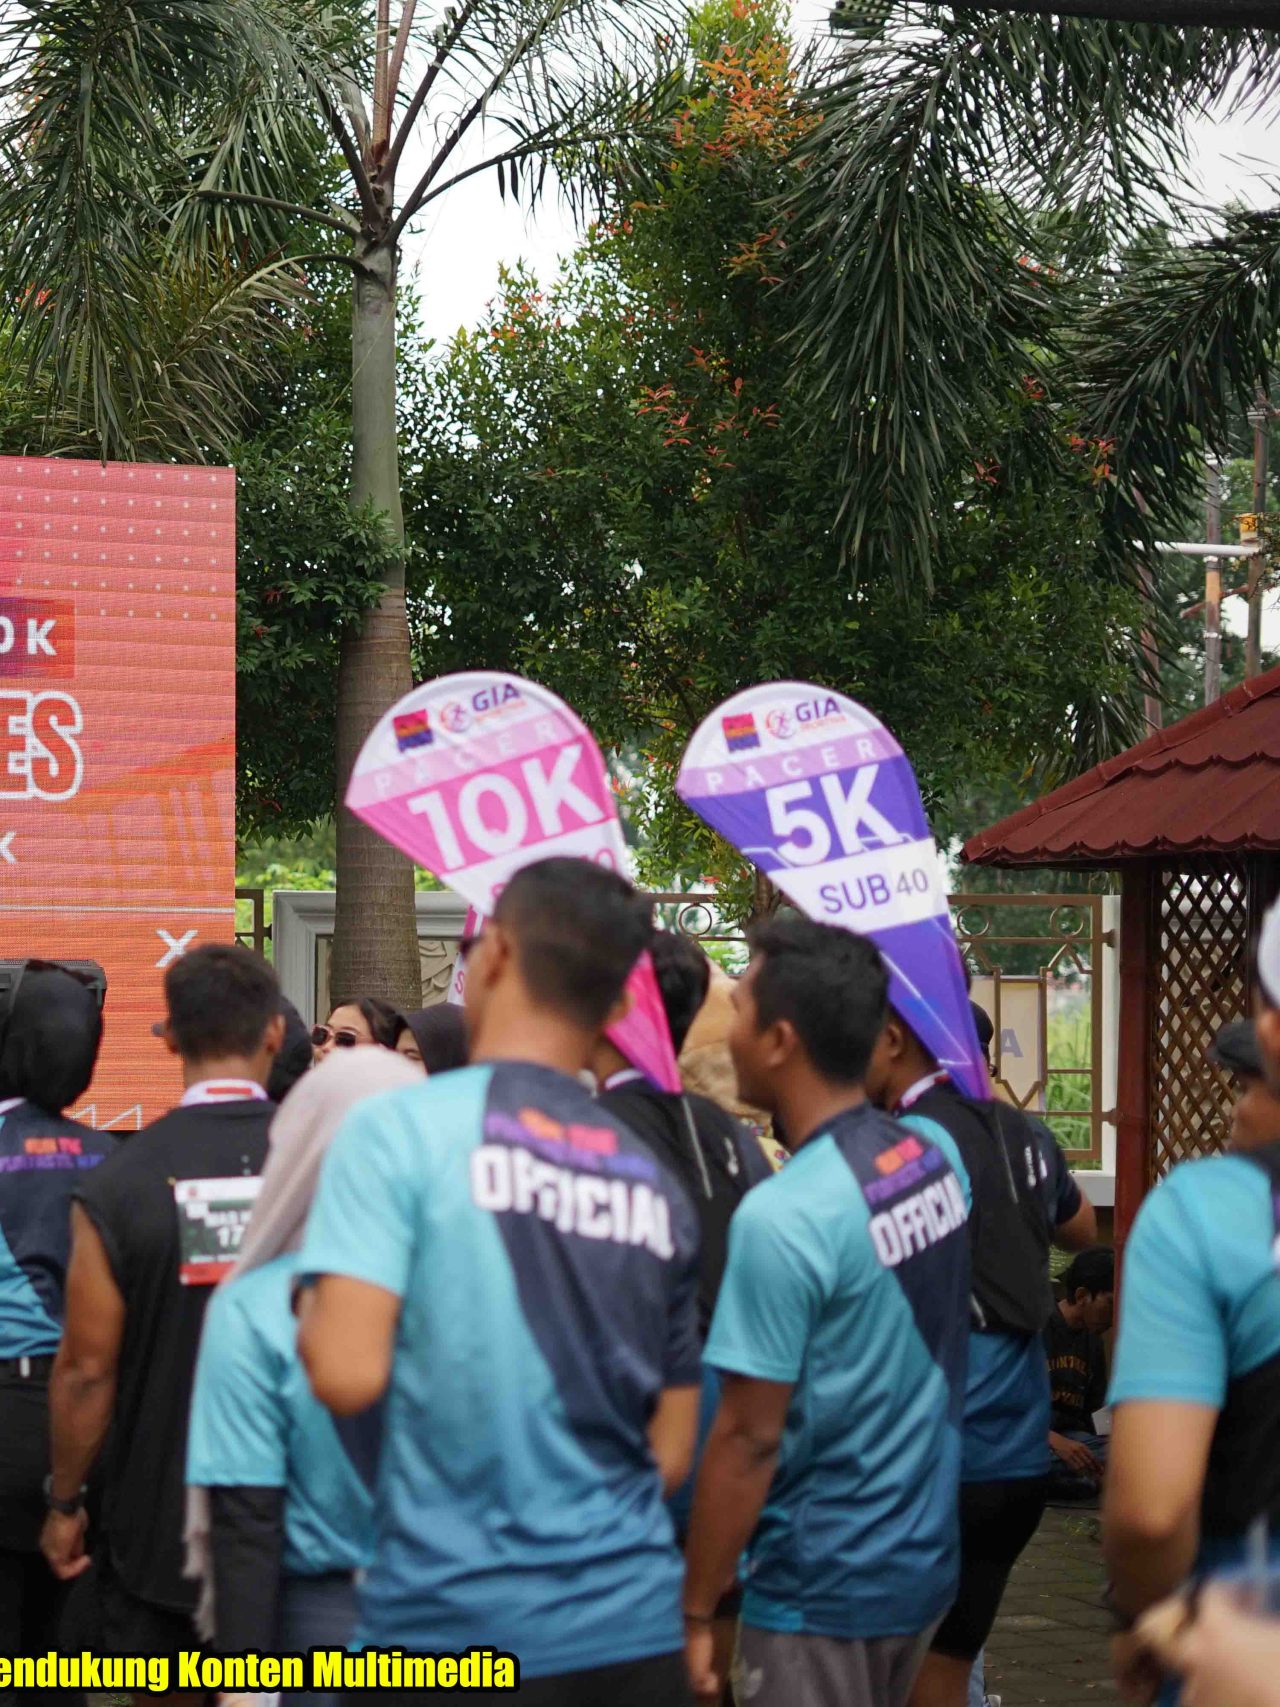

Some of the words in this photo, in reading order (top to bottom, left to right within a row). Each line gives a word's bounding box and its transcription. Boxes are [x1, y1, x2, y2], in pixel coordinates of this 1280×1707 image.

[26, 618, 58, 656] K
[471, 682, 520, 712] GIA
[795, 696, 841, 723] GIA
[374, 720, 557, 795] PACER
[705, 738, 876, 792] PACER
[406, 744, 606, 871] 10K
[765, 763, 904, 866] 5K
[820, 873, 891, 914] SUB
[896, 868, 929, 894] 40
[471, 1144, 676, 1262] OFFICIAL
